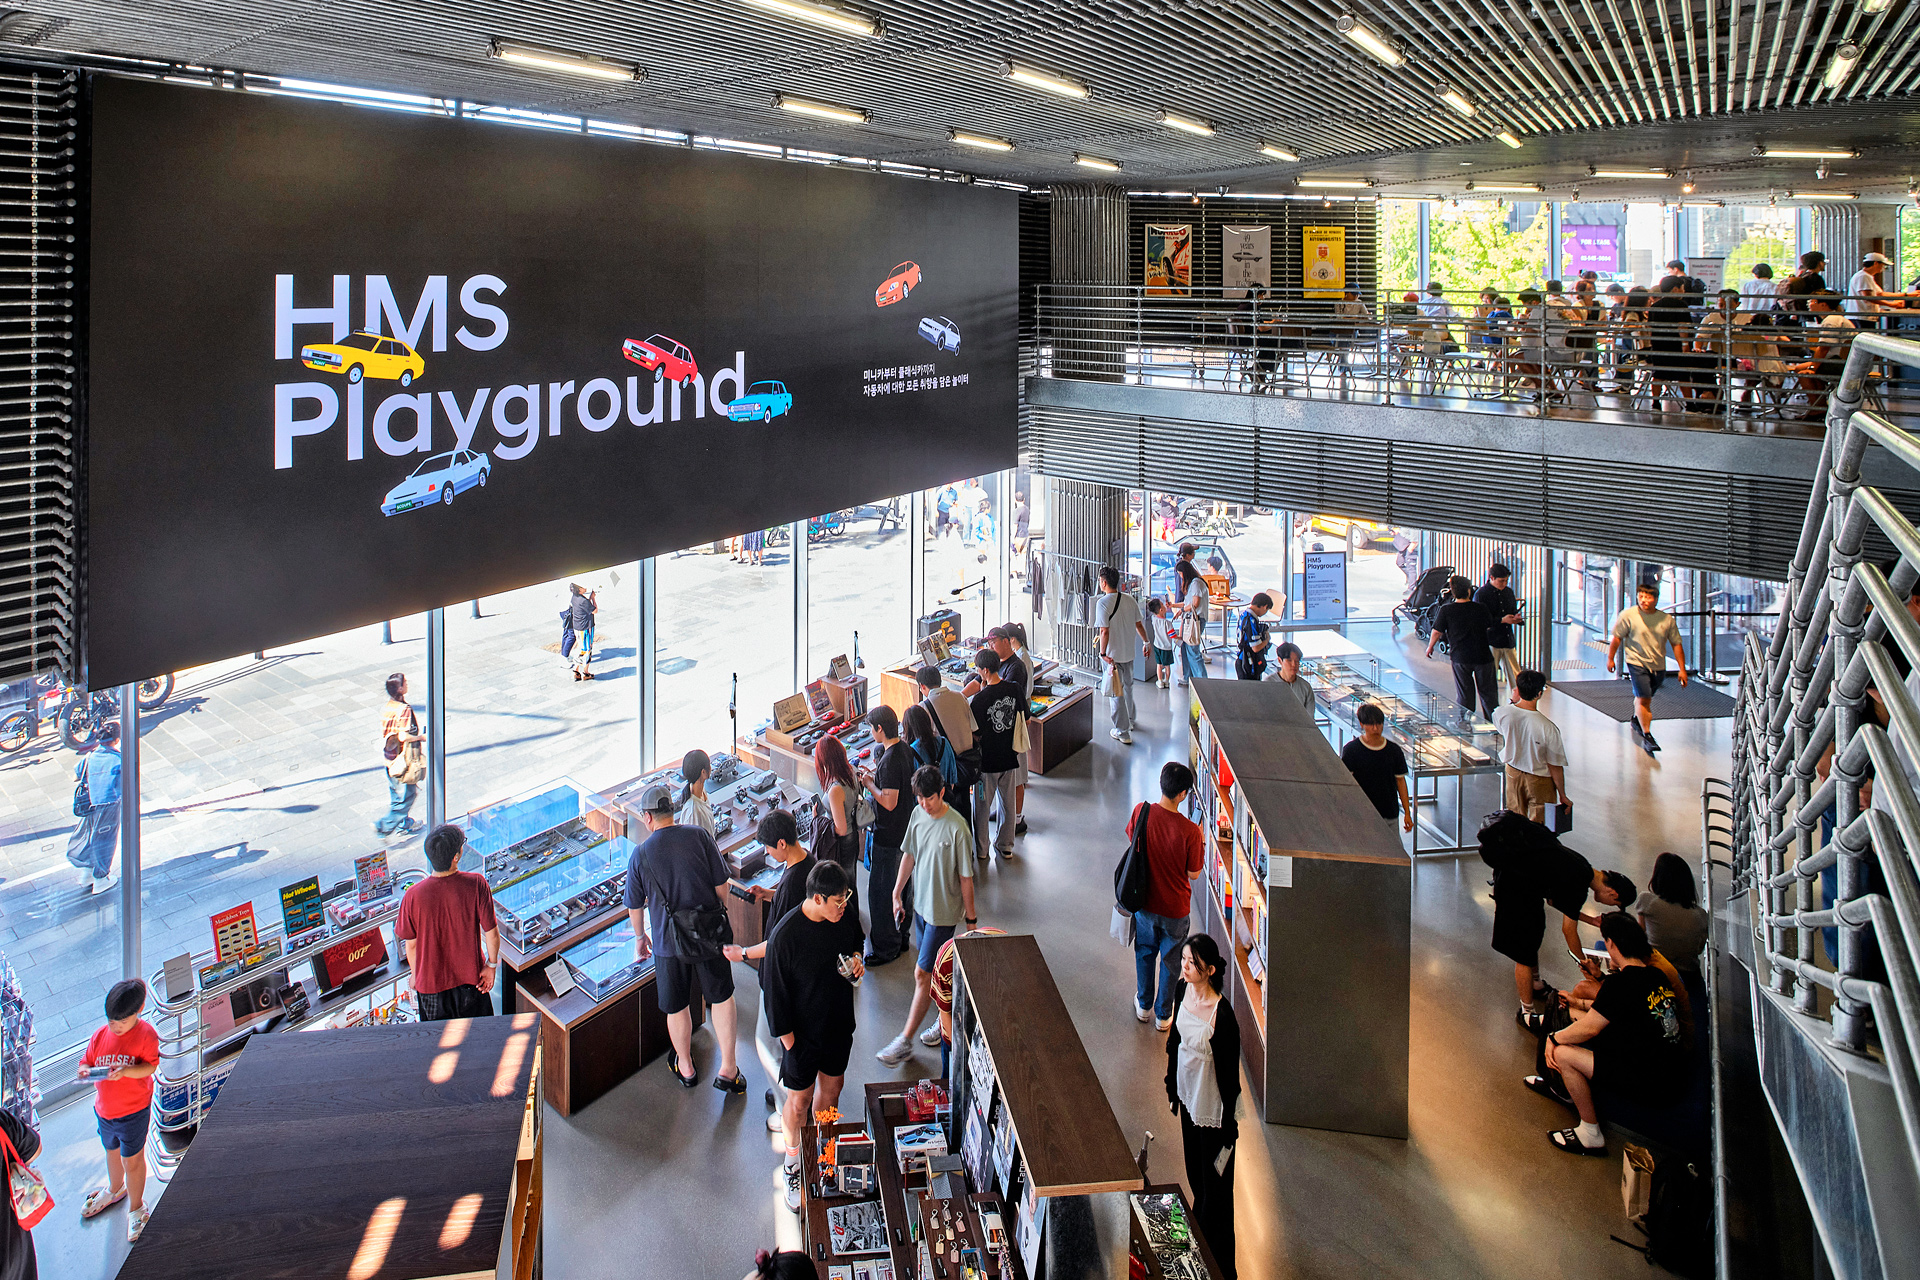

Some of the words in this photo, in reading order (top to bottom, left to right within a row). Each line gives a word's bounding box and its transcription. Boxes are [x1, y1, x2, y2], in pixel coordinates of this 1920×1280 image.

[1240, 243, 1255, 252] years
[1242, 268, 1252, 278] the
[1244, 260, 1251, 269] in
[274, 273, 510, 360] HMS
[863, 367, 897, 381] 미니카부터
[863, 381, 891, 397] 자동차에
[891, 380, 905, 394] 대한
[905, 379, 919, 392] 모든
[919, 377, 939, 391] 취향을
[939, 375, 951, 388] 담은
[952, 372, 969, 387] 놀이터
[273, 351, 746, 470] Playground
[283, 890, 295, 900] Hot
[294, 883, 317, 896] Wheels
[215, 913, 239, 925] Matchbox
[238, 908, 250, 916] Toys
[348, 945, 367, 963] 007
[94, 1053, 136, 1067] CHELSEA
